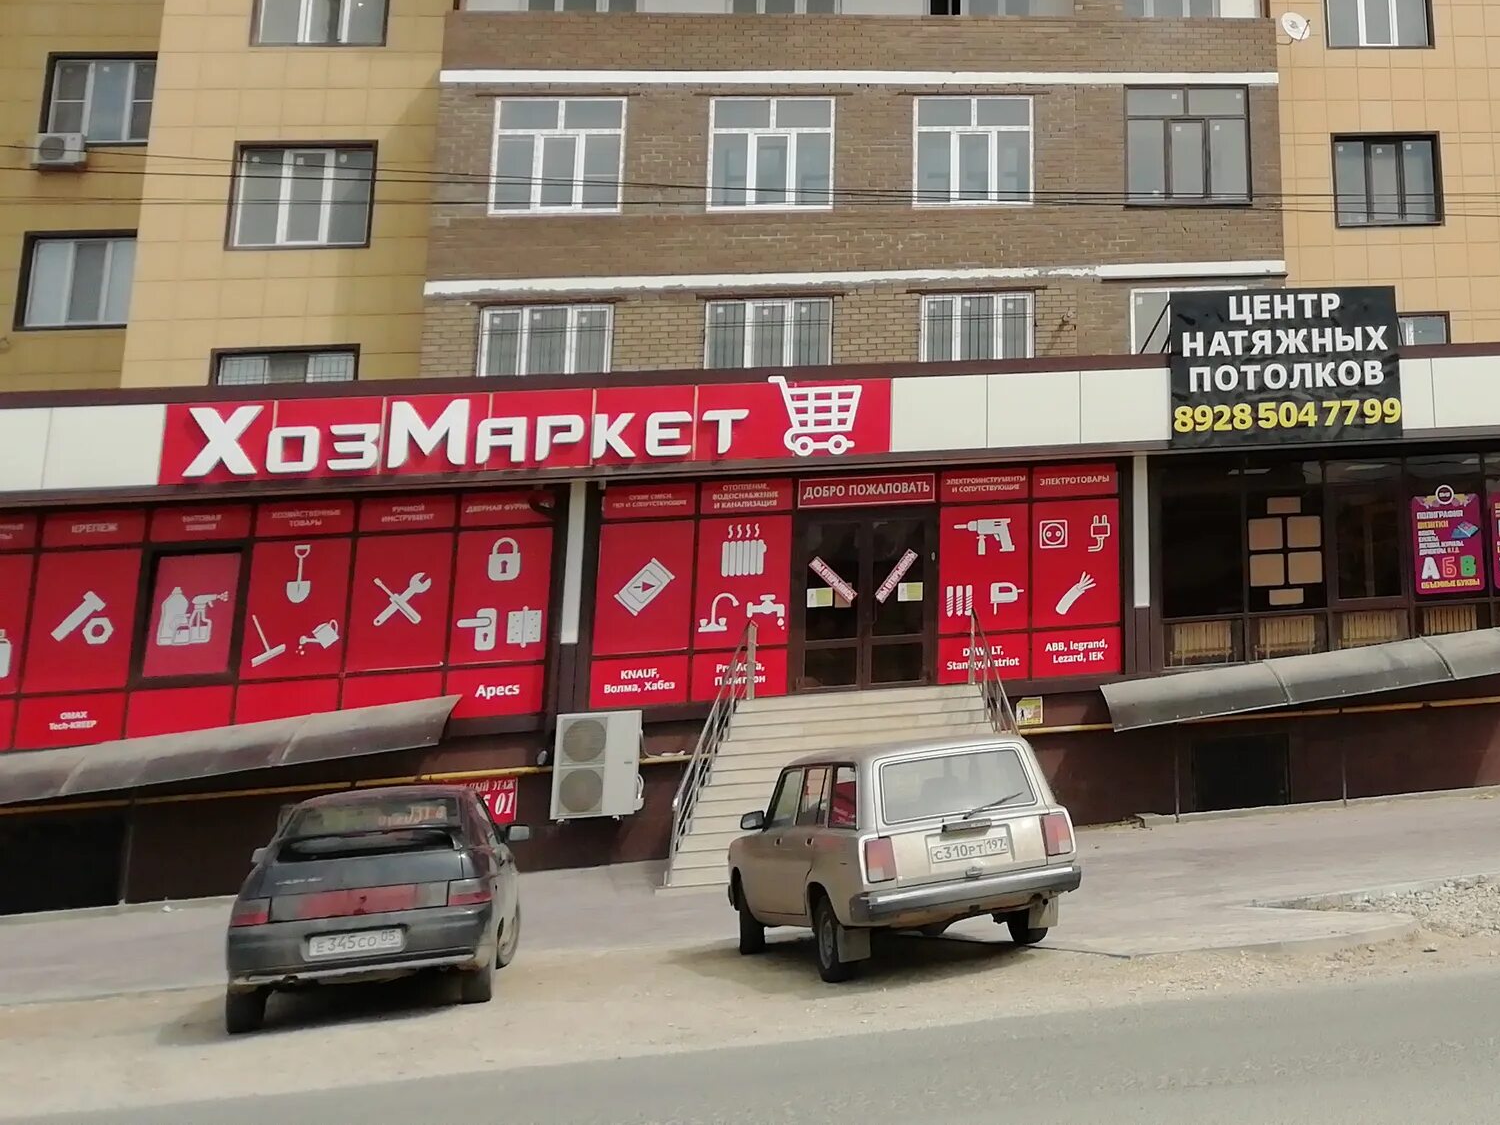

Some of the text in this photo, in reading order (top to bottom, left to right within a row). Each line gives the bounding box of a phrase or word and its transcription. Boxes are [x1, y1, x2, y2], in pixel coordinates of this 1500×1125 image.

[1228, 293, 1341, 325] ЦЕНТР
[1182, 325, 1388, 358] НАТЯЖНЫХ
[1188, 359, 1385, 393] ПОТОЛКОВ
[1173, 402, 1253, 433] 8928
[1257, 400, 1318, 430] 504
[181, 398, 750, 478] ХозМаркет
[946, 475, 1026, 486] ЭЛЕКТРОИНСТРУМЕНТЫ
[959, 483, 1020, 493] СОПУТСТВУЮЩИЕ
[1039, 475, 1110, 486] ЭЛЕКТРОТОВАРЫ
[803, 481, 930, 499] ДОБРО ПОЖАЛОВАТЬ
[721, 500, 778, 509] КАНАЛИЗАЦИЯ
[289, 518, 322, 527] ТОВАРЫ
[1421, 555, 1476, 580] А Б В
[963, 645, 1004, 657] DWLT,
[1045, 639, 1108, 652] ABB, legrand,
[1053, 651, 1104, 663] Lezard, IEK
[620, 668, 659, 679] KNAUF,
[475, 684, 520, 699] Apecs
[604, 680, 675, 693] Волма, Хабез
[494, 792, 515, 815] 01
[933, 837, 1004, 860] С310РТ 197
[316, 929, 396, 953] Е345СО 05
